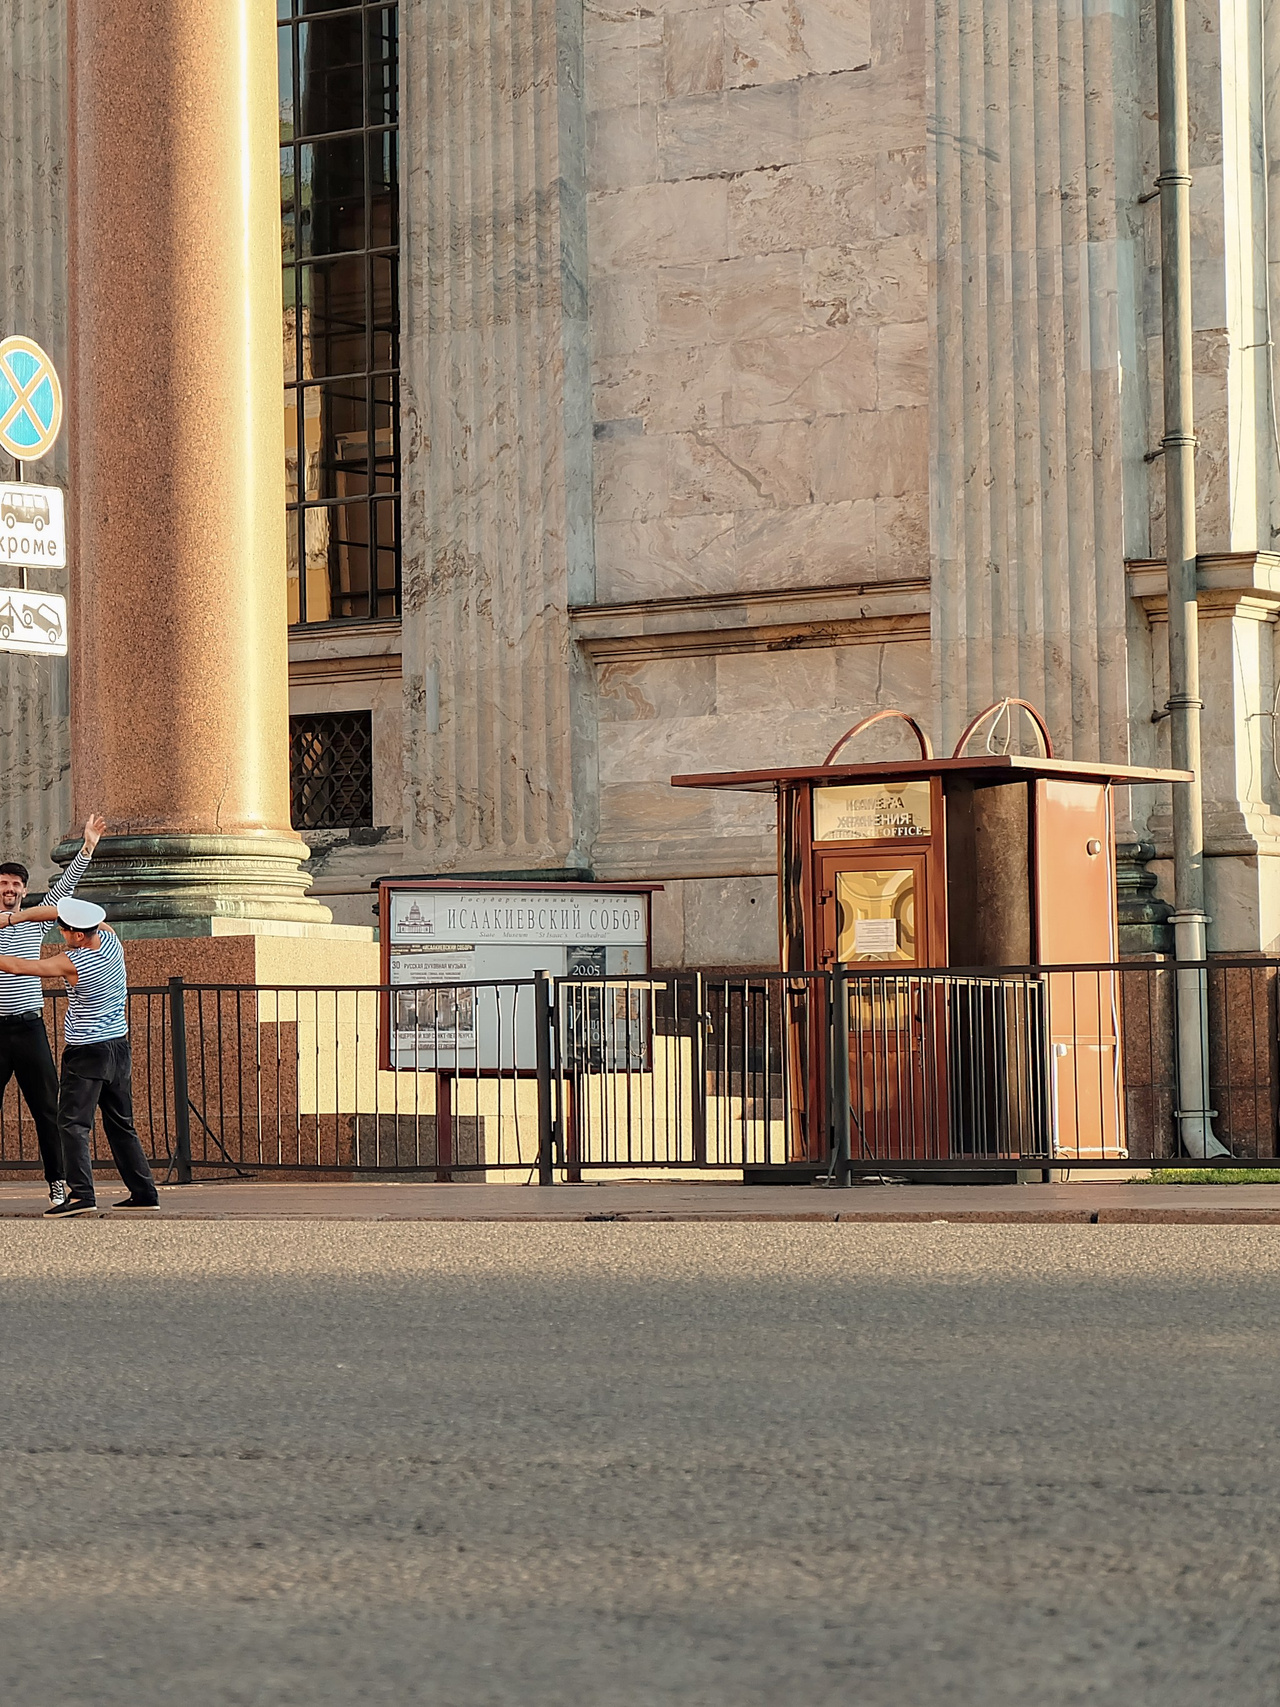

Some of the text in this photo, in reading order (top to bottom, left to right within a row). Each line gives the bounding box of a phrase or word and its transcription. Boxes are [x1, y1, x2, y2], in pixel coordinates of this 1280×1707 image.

[447, 904, 640, 930] ИСААКИЕВСКИЙ СОБОР
[392, 960, 401, 970] 30
[572, 964, 601, 976] 20.05
